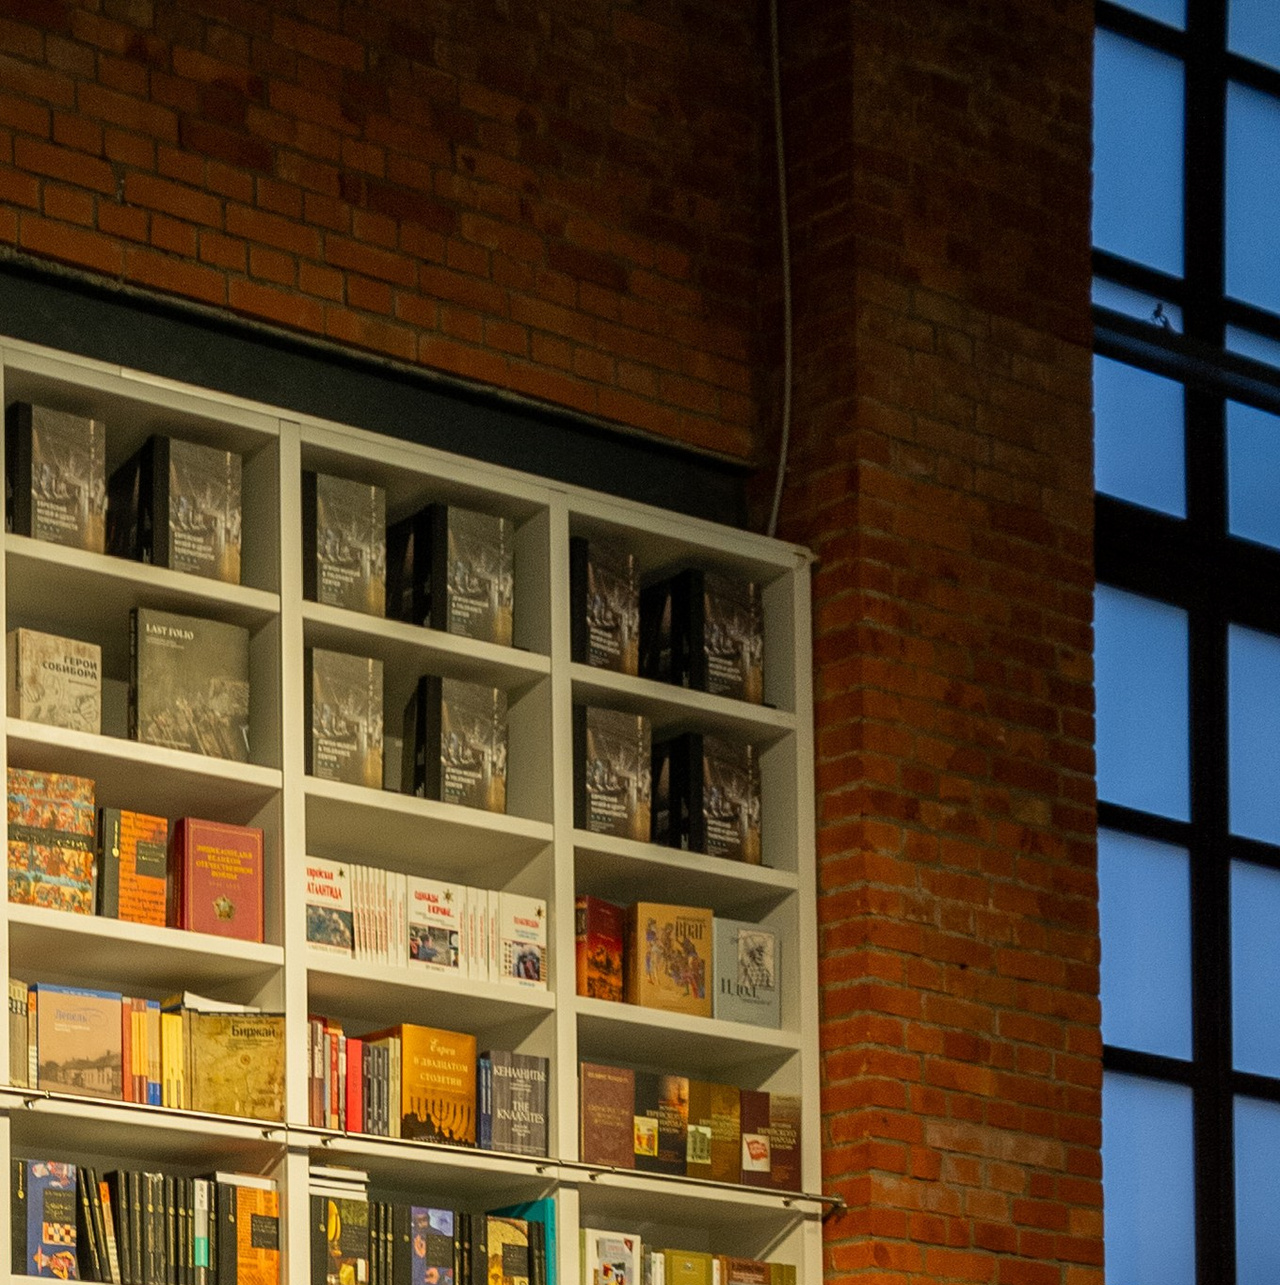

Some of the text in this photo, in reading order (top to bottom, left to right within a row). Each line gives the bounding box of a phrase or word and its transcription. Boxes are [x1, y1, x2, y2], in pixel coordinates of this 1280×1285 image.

[145, 623, 194, 641] LAST FOLIO
[64, 655, 97, 670] ГЕРОИ
[42, 661, 97, 680] СОБИБОРА
[231, 1024, 276, 1039] Биржай
[513, 1100, 530, 1111] THE
